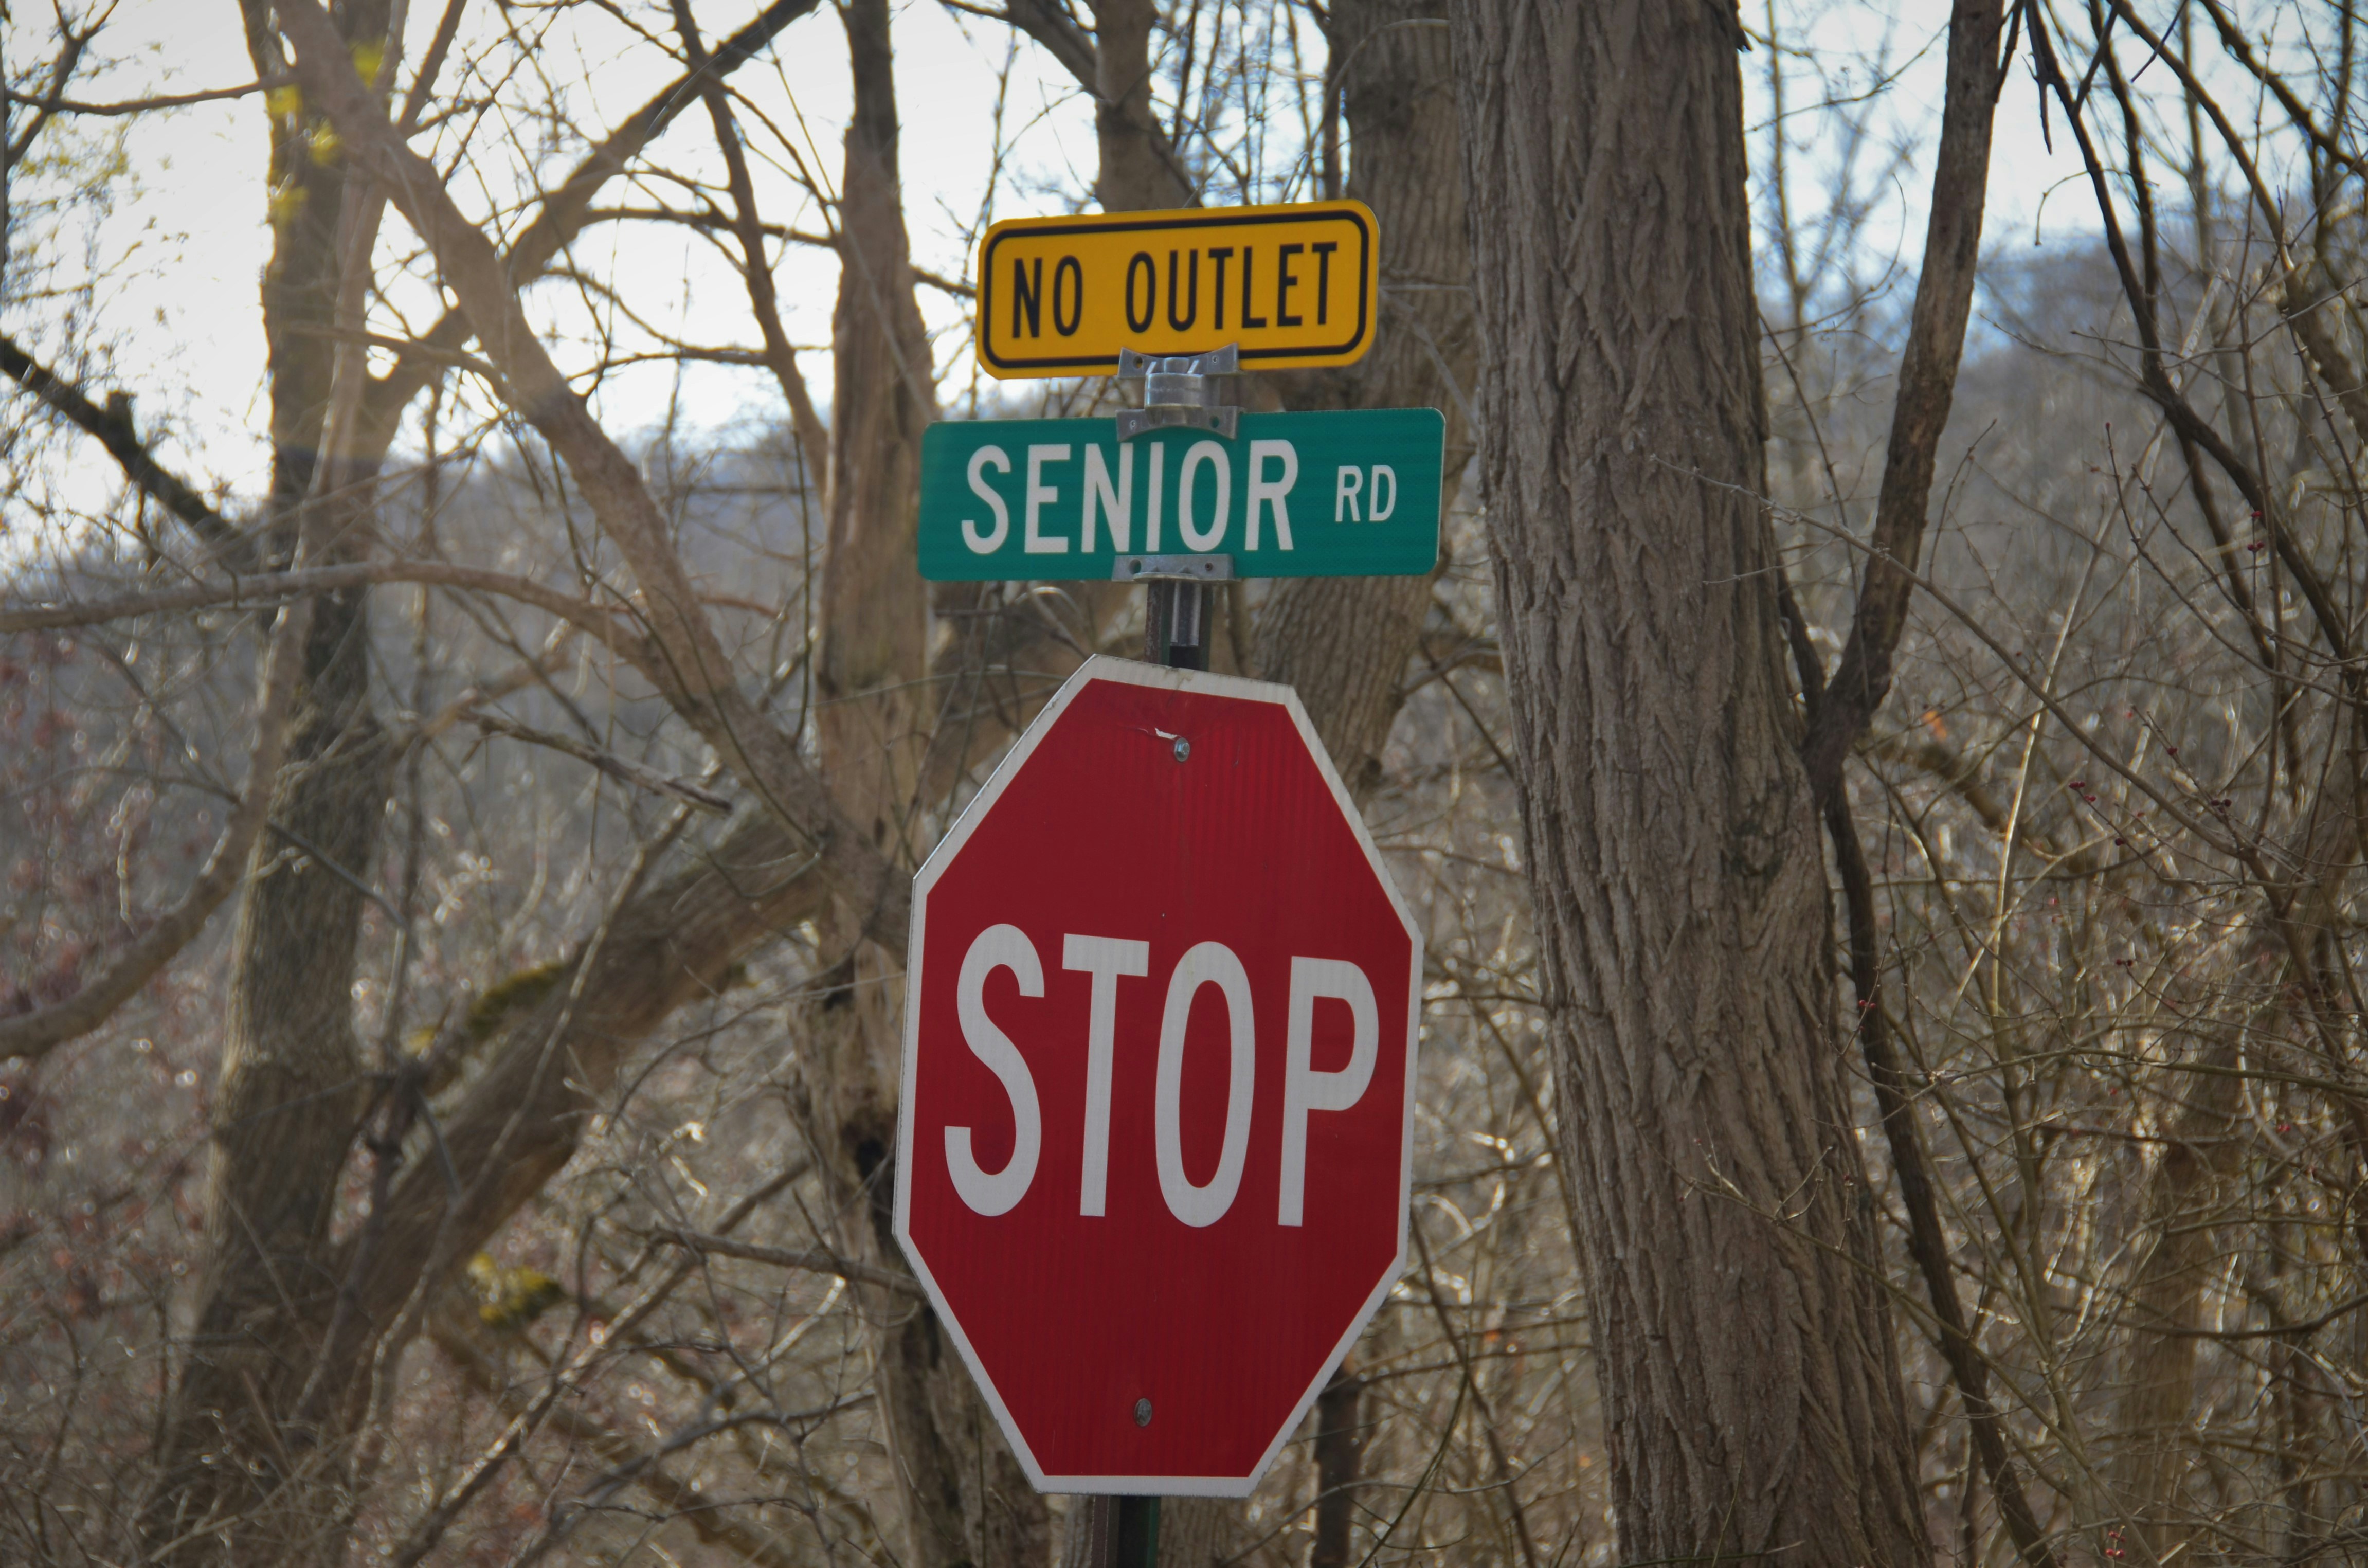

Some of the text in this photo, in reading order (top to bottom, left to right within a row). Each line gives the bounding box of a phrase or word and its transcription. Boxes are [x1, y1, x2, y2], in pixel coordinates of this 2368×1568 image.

[1011, 241, 1338, 339] NO OUTLET
[961, 439, 1397, 554] SENIOR RD
[944, 923, 1380, 1228] STOP
